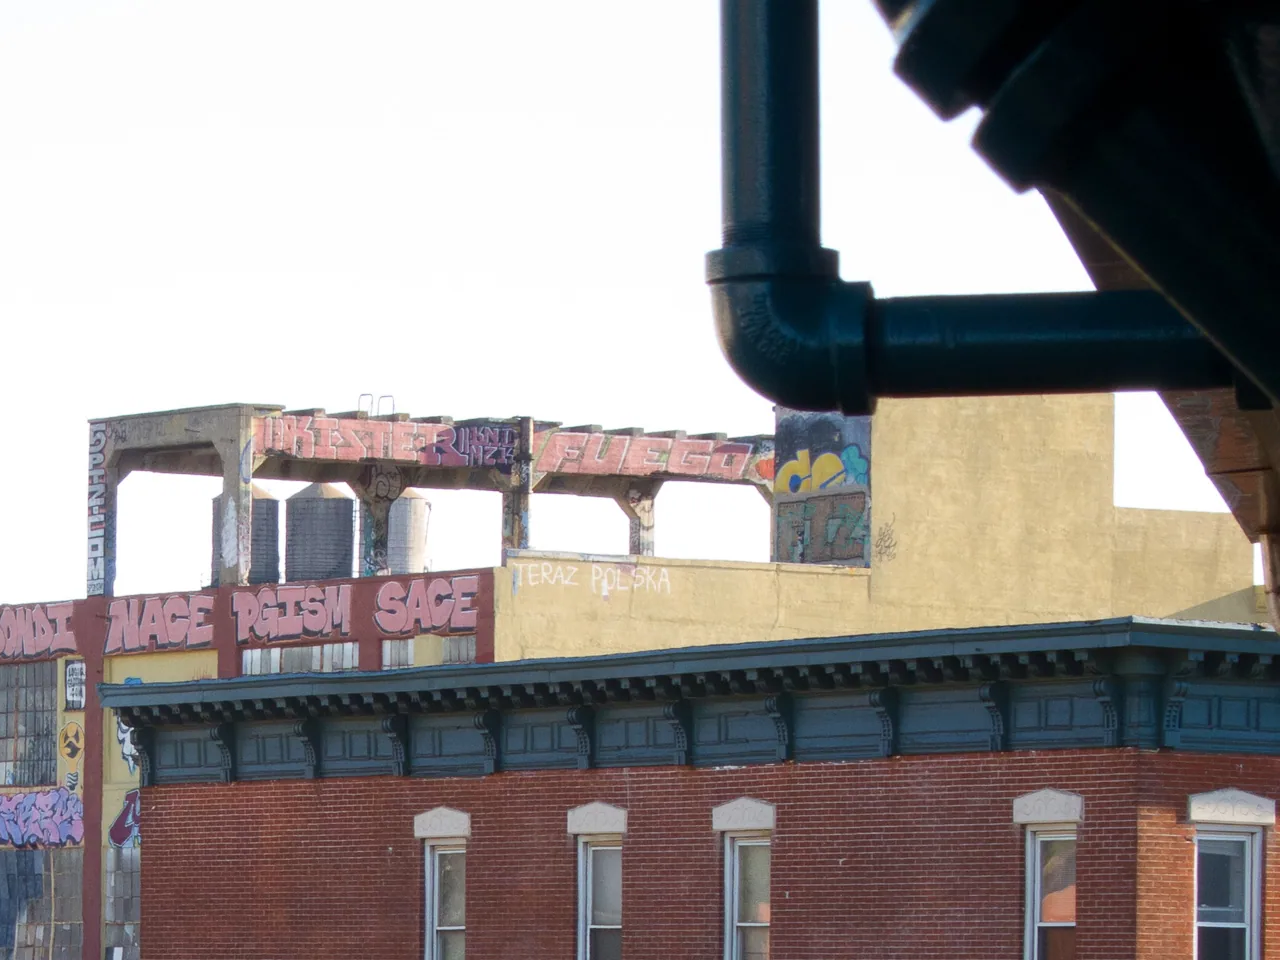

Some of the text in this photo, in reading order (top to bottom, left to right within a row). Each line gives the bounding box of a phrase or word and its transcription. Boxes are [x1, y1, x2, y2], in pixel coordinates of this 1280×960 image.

[538, 433, 753, 477] FUEGO
[374, 574, 479, 635] SACE
[514, 563, 671, 595] TERAZ POLSKA
[103, 595, 215, 655] NACE
[231, 583, 353, 645] PGISM
